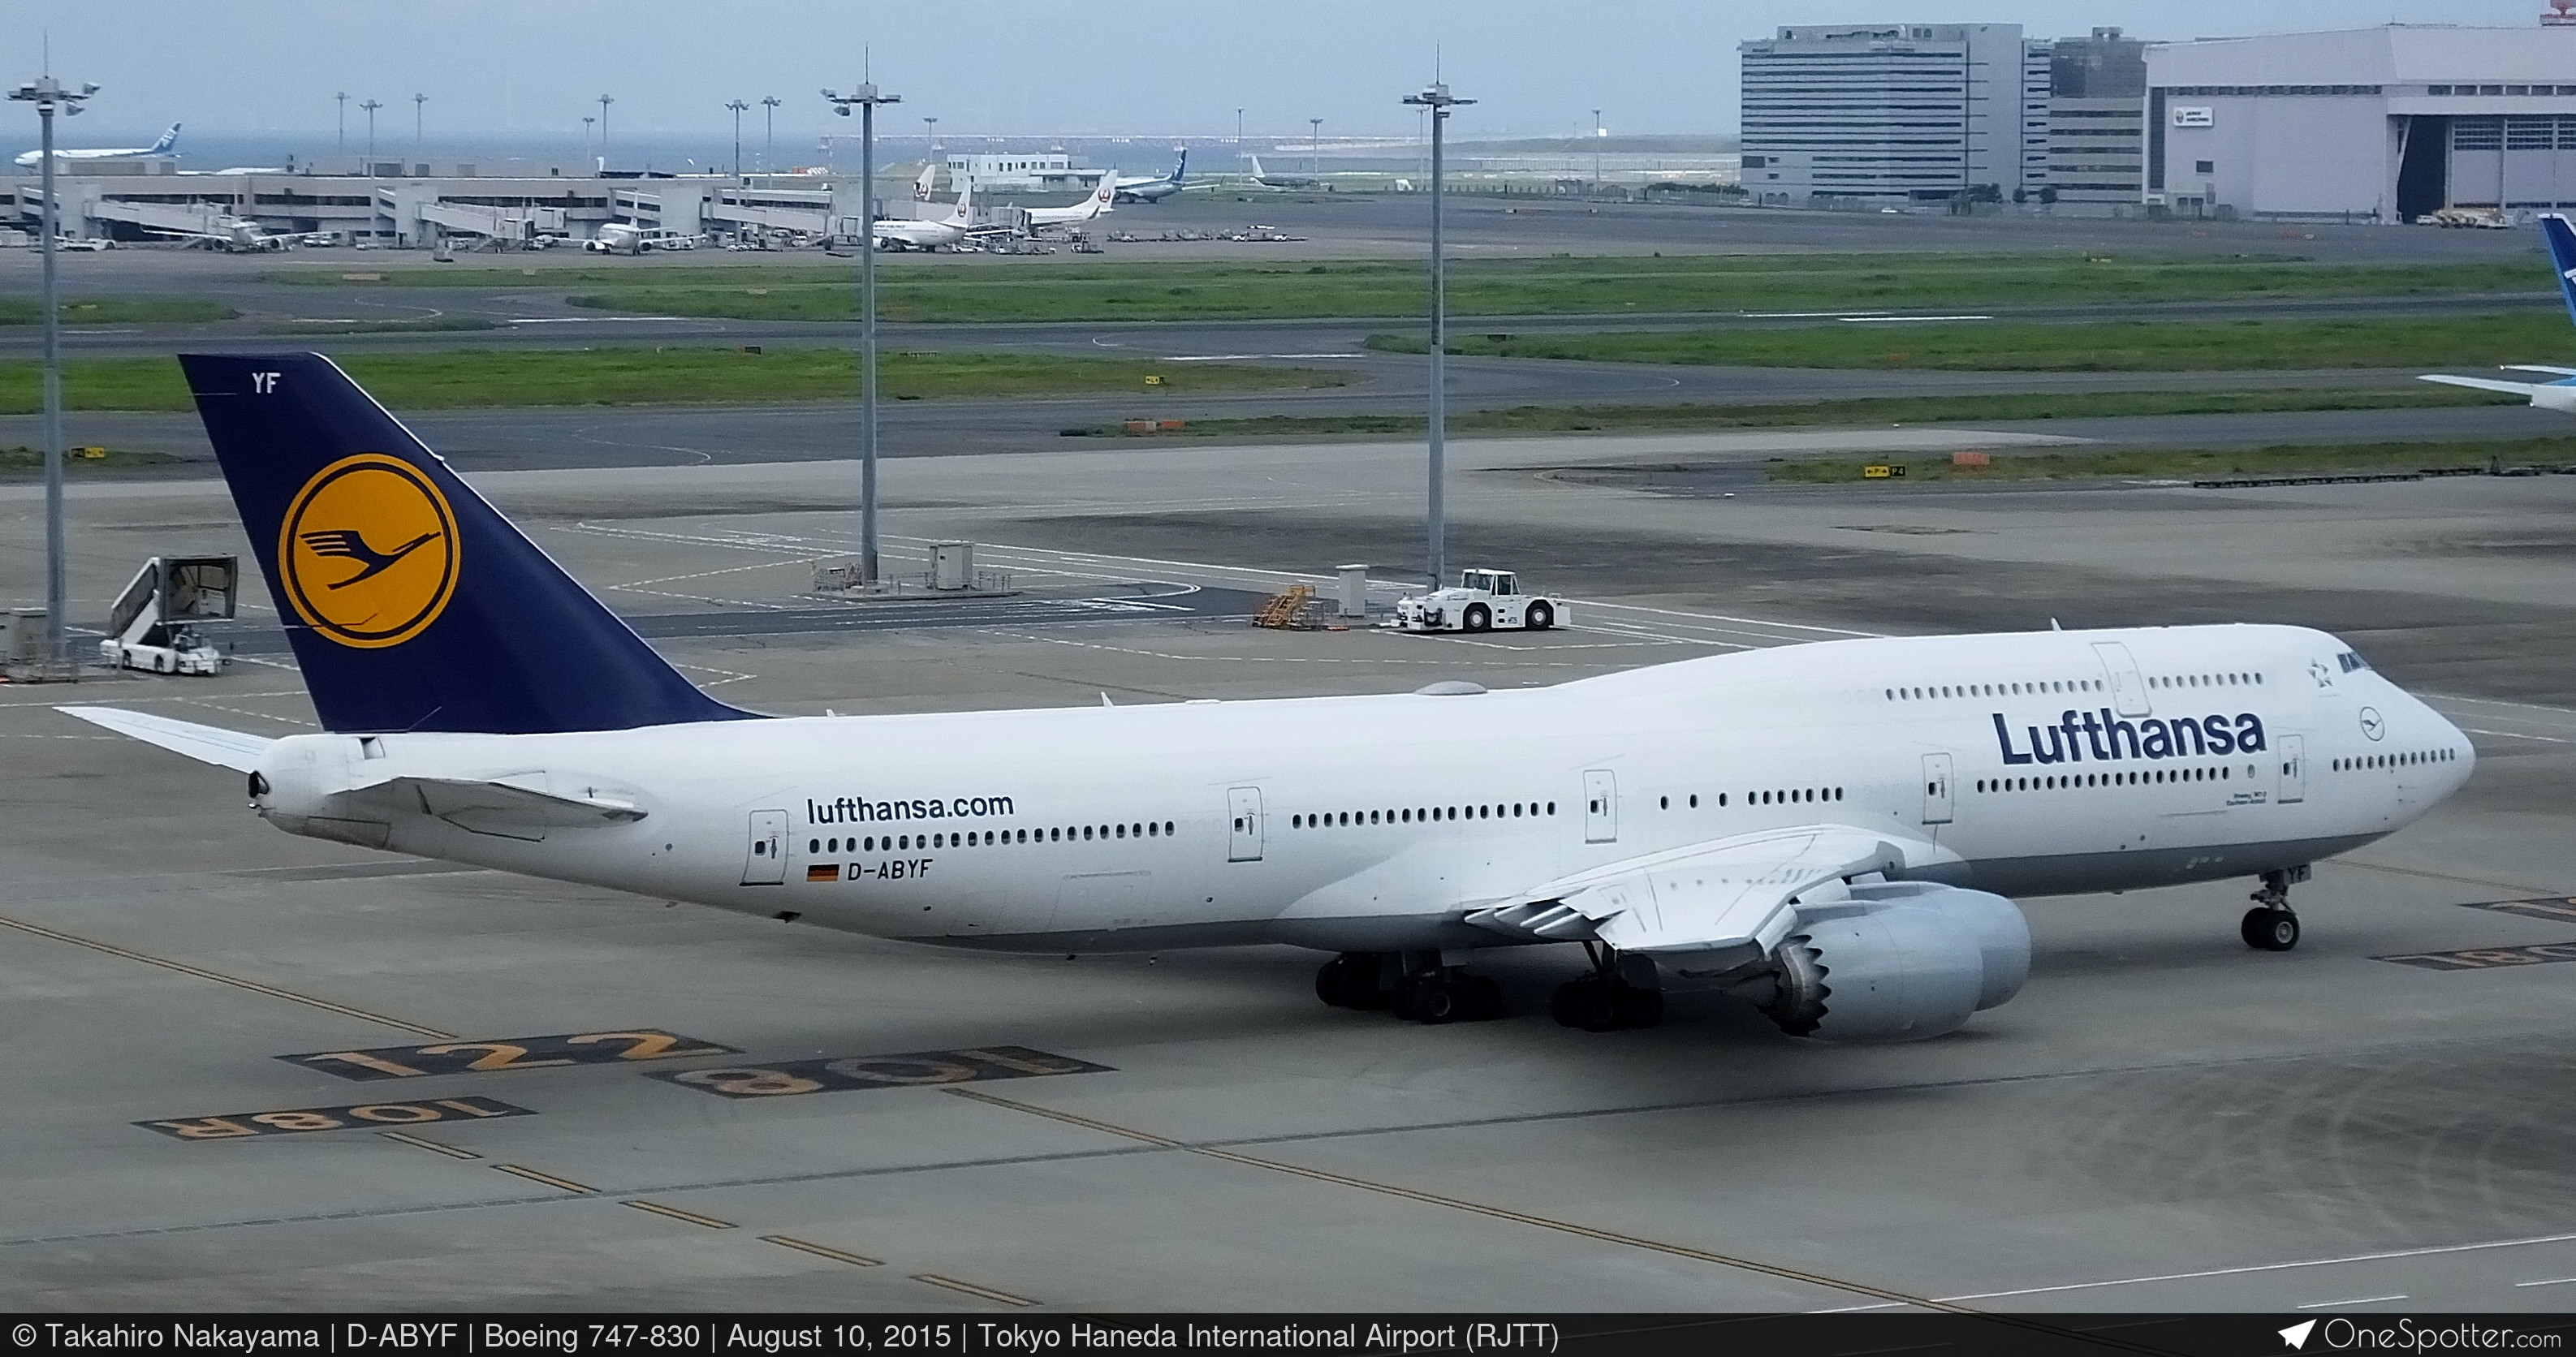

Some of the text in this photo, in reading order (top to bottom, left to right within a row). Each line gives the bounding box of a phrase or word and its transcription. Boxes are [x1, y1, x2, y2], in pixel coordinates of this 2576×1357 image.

[252, 372, 281, 394] YF
[1992, 708, 2267, 765] Lufthansa
[807, 796, 1014, 825] lufthansa.com
[848, 859, 933, 881] D-ABYF
[2287, 864, 2308, 884] YF
[304, 1032, 730, 1078] 122
